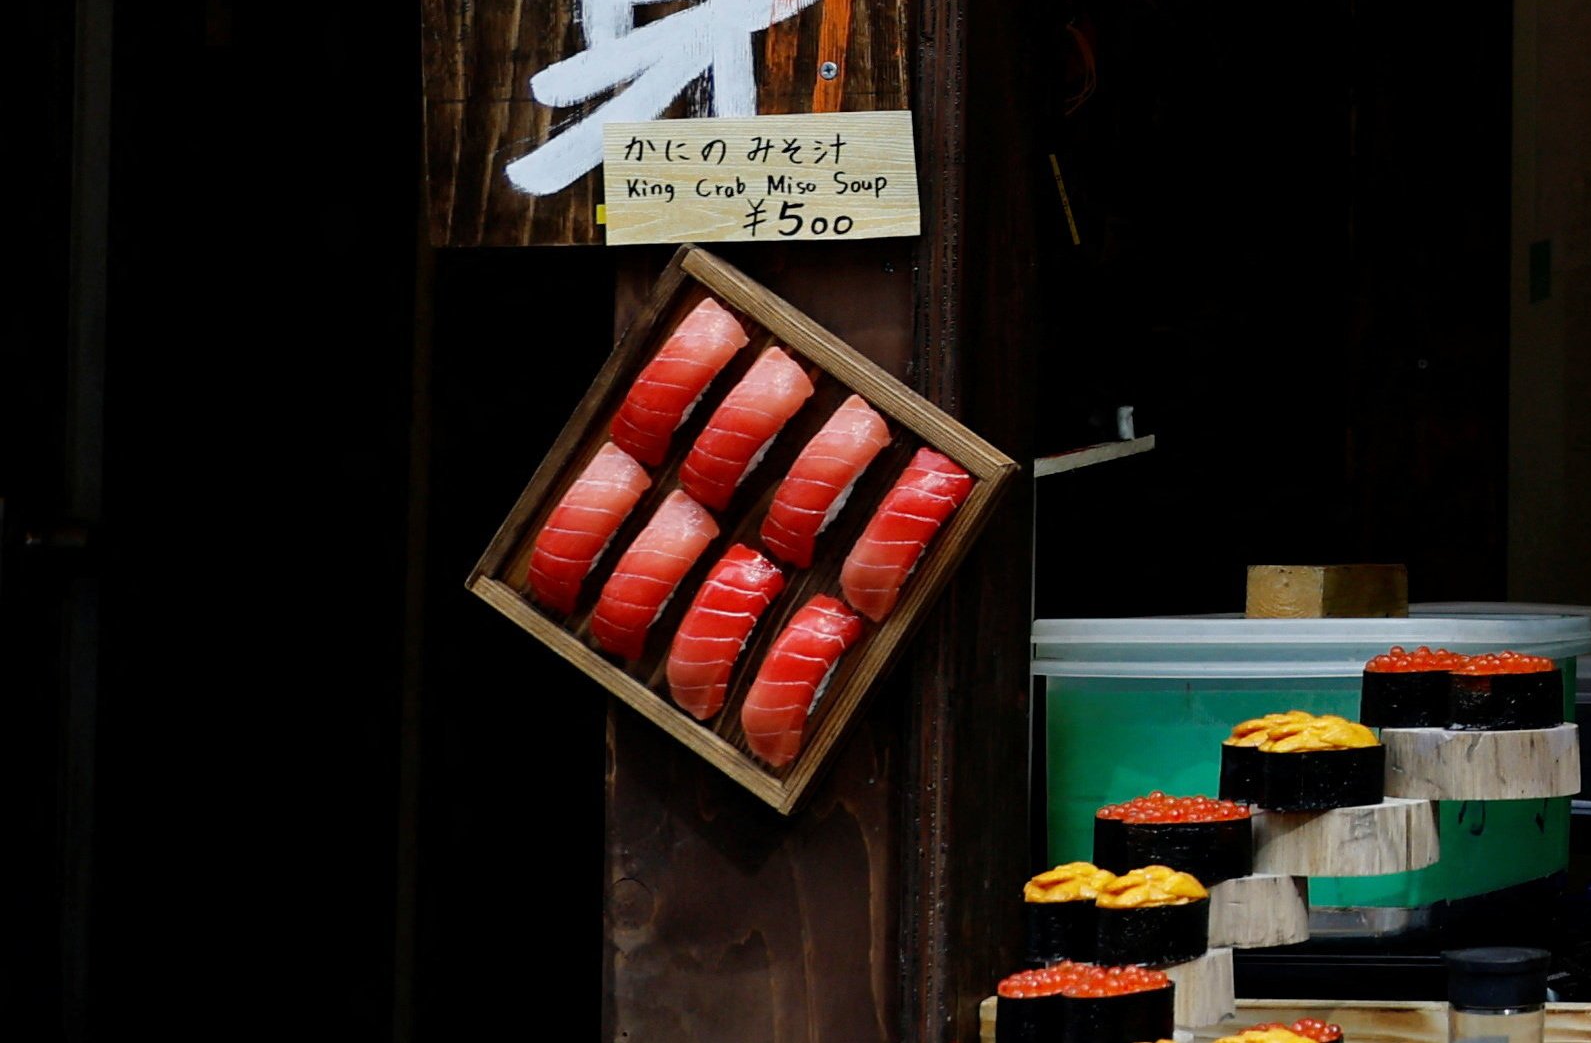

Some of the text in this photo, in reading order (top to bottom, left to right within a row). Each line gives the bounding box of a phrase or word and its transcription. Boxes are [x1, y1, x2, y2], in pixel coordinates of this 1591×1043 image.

[626, 171, 888, 203] King Crab Miso Soup
[743, 199, 854, 237] ¥500
